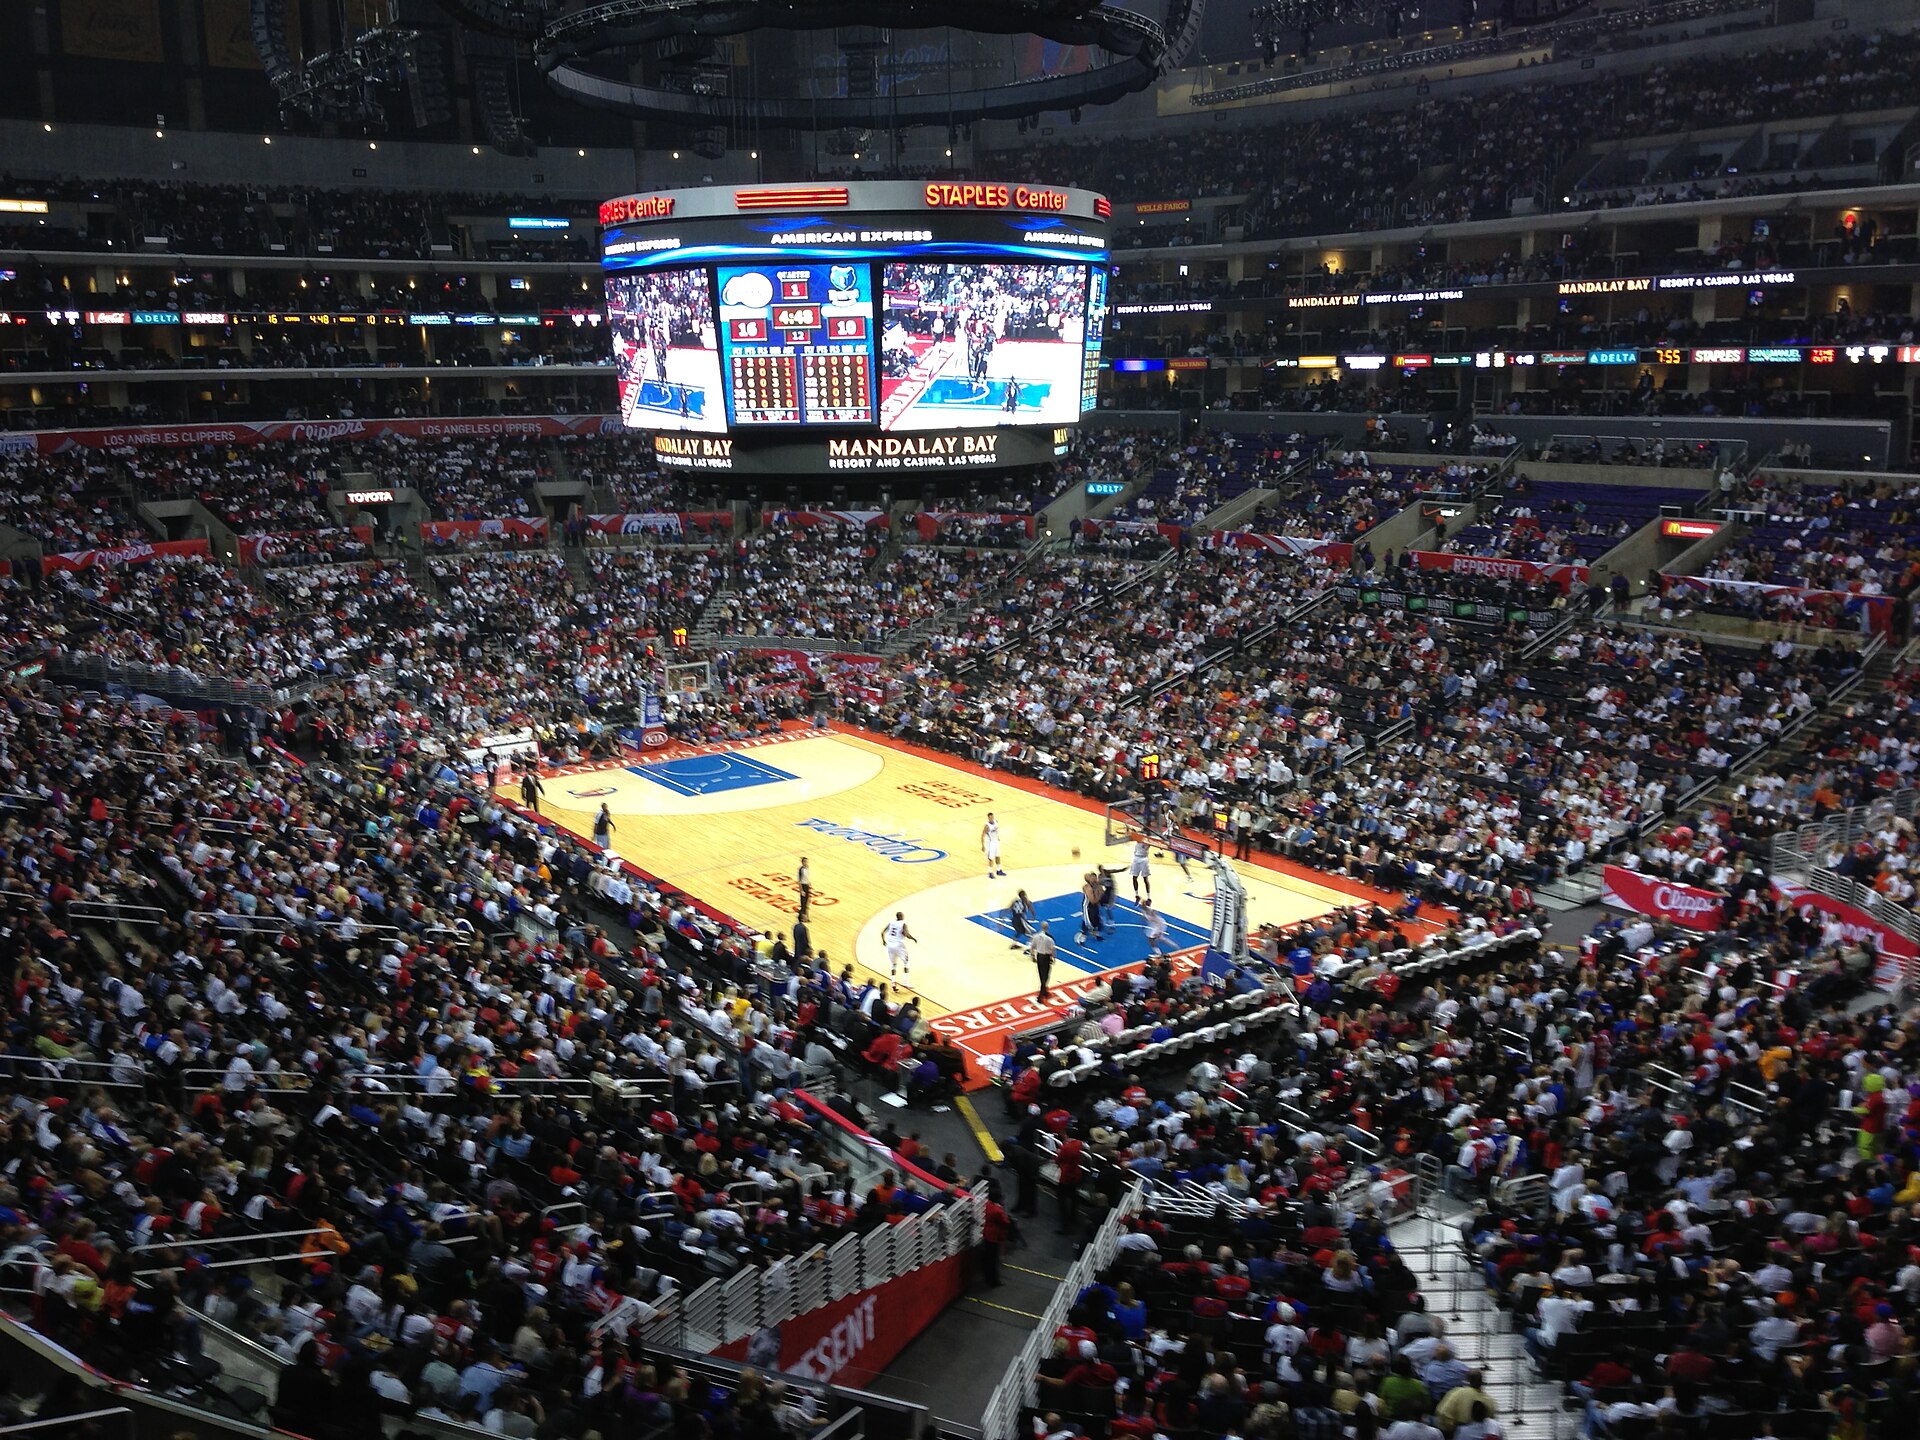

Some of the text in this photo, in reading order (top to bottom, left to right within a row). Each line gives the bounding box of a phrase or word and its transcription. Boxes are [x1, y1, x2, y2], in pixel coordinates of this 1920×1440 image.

[925, 184, 1068, 209] STAPLES Center
[627, 195, 673, 219] Center
[1136, 202, 1189, 212] WELLS FARGO
[770, 230, 933, 245] AMERICAN EXPRESS
[1559, 279, 1650, 294] MANDALAY BAY
[1660, 278, 1694, 288] RESORT
[1704, 276, 1740, 286] CASINO
[1742, 274, 1761, 284] LAS
[1762, 273, 1795, 283] VEGAS
[790, 284, 799, 295] 1
[1289, 295, 1359, 308] MANDALAY BAY
[145, 314, 179, 322] DELTA
[185, 313, 225, 324] STAPLES
[268, 314, 278, 324] 16
[309, 314, 330, 325] 4:48
[367, 315, 376, 324] 10
[737, 322, 758, 336] 16
[837, 320, 857, 335] 10
[1541, 353, 1586, 364] Budweiser
[1600, 353, 1636, 362] DELTA
[1656, 349, 1680, 364] 7:55
[1694, 349, 1741, 362] STAPLES
[291, 421, 366, 441] Clippers
[421, 424, 441, 435] LOS
[443, 424, 490, 434] ANGELES
[104, 430, 236, 446] LOS ANGELES CLIPPERS
[703, 439, 733, 456] BAY
[829, 435, 998, 457] MANDALAY BAY
[829, 458, 872, 469] RESORT
[876, 458, 900, 468] AND
[948, 456, 966, 465] LAS
[967, 454, 997, 464] VEGAS
[347, 491, 394, 503] TOYOTA
[93, 543, 155, 567] Clippers
[1453, 557, 1522, 578] REPRESENT
[647, 734, 664, 744] KIA
[1143, 764, 1158, 779] 11
[922, 780, 994, 804] Center
[792, 817, 950, 864] Clippers
